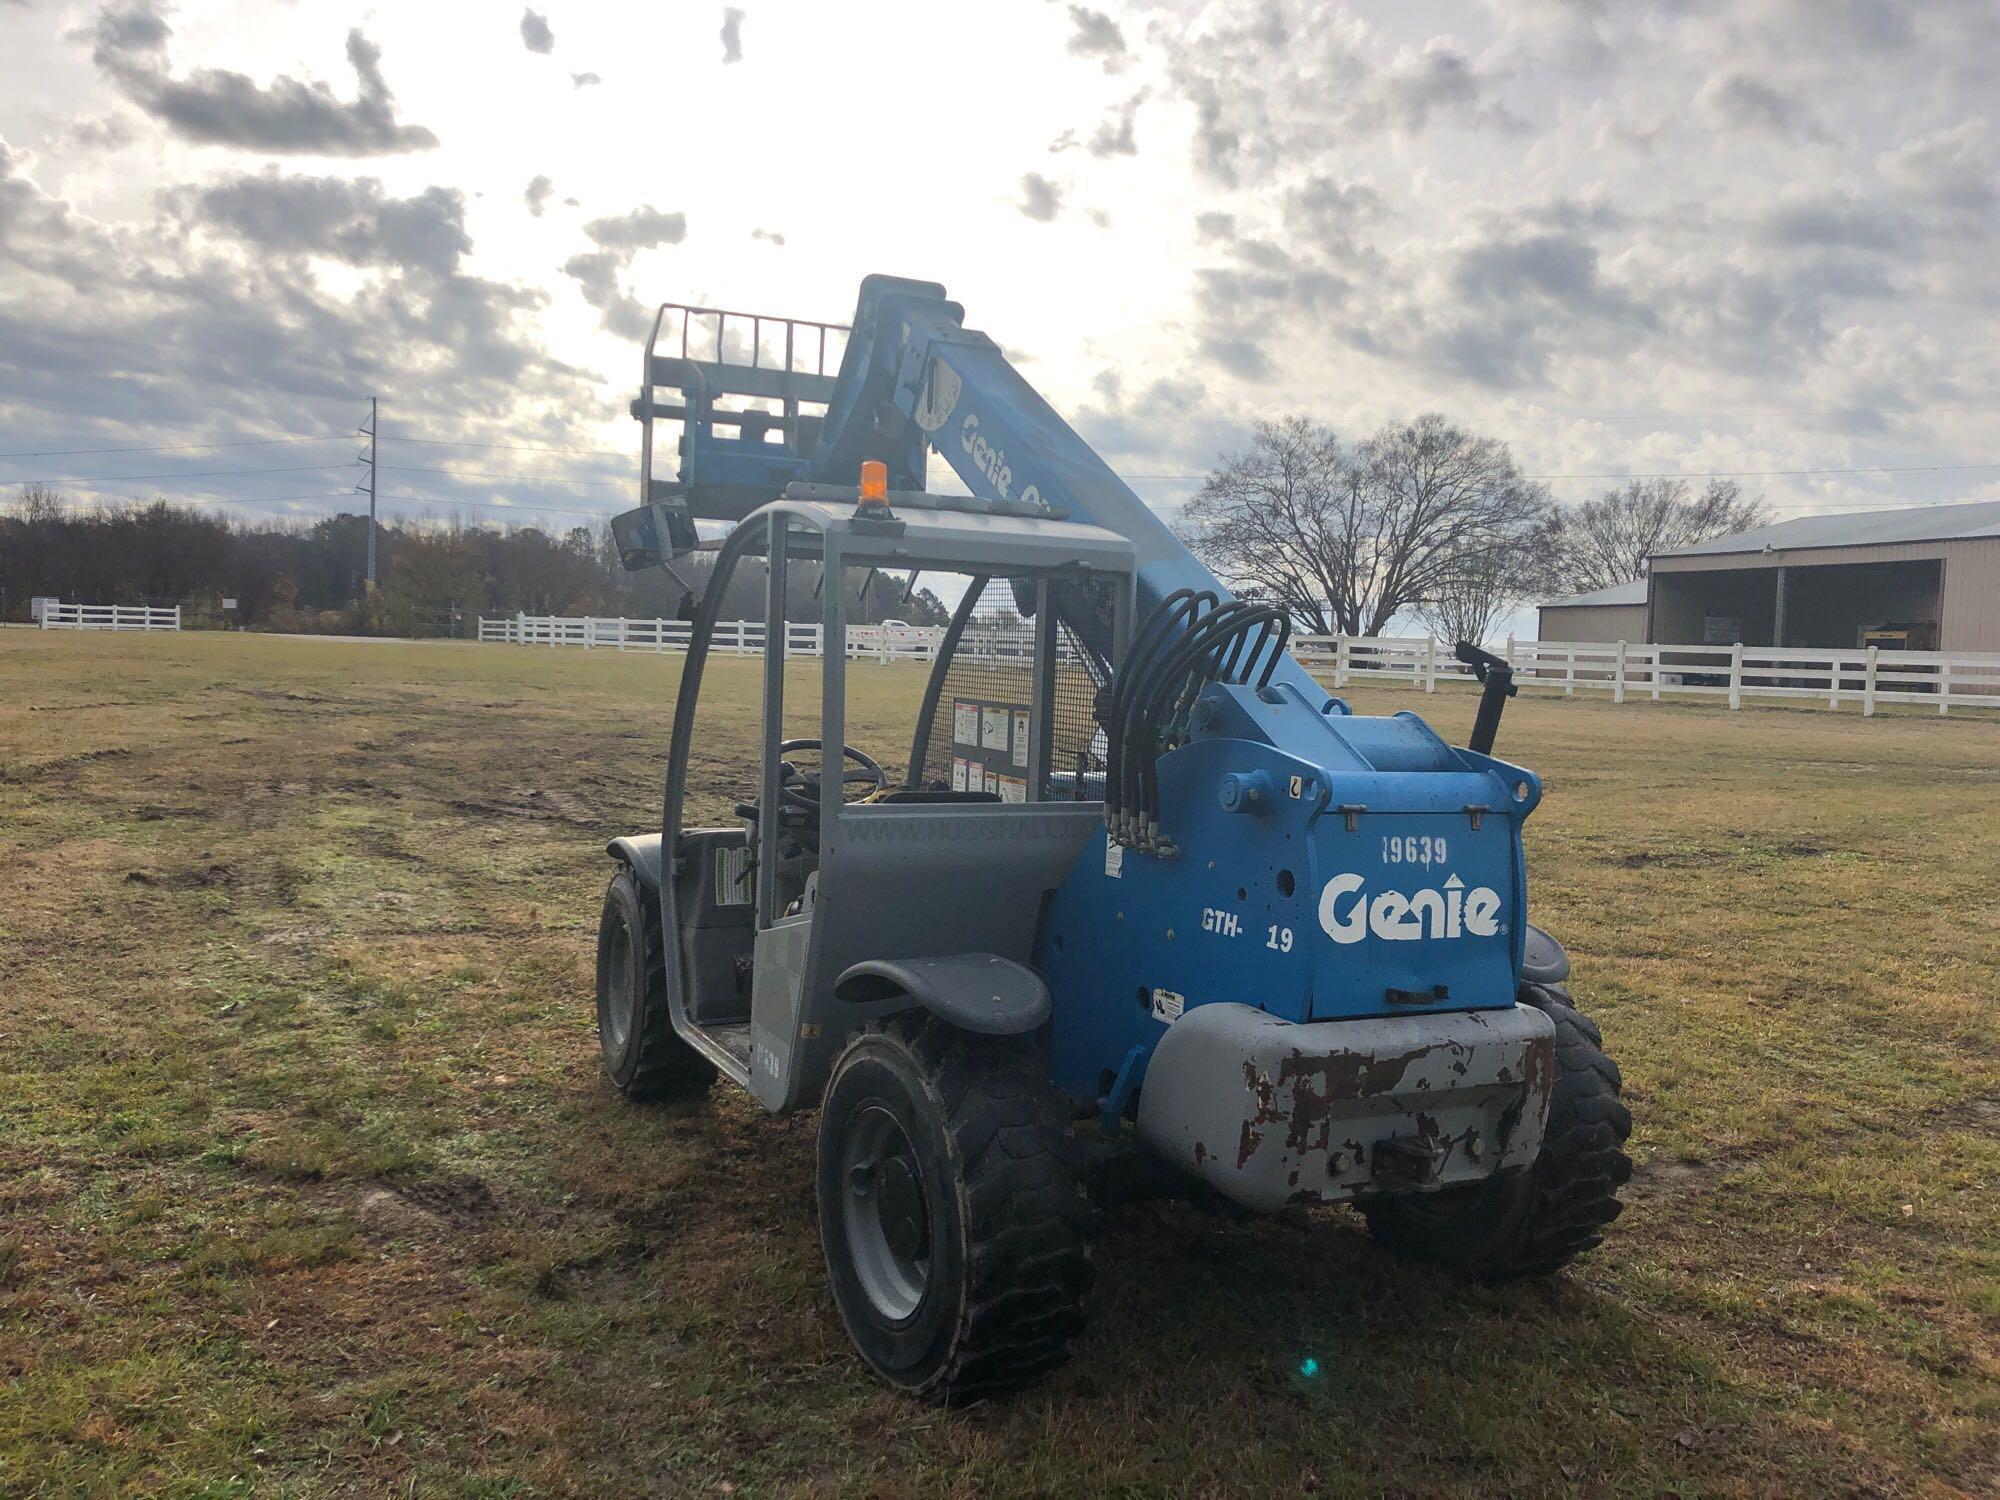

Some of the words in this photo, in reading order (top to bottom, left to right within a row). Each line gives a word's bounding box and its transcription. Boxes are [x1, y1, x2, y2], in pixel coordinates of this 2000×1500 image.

[961, 414, 1012, 498] Genie
[1382, 836, 1447, 864] 19639
[1202, 907, 1243, 938] GTH-
[1266, 924, 1293, 953] 19
